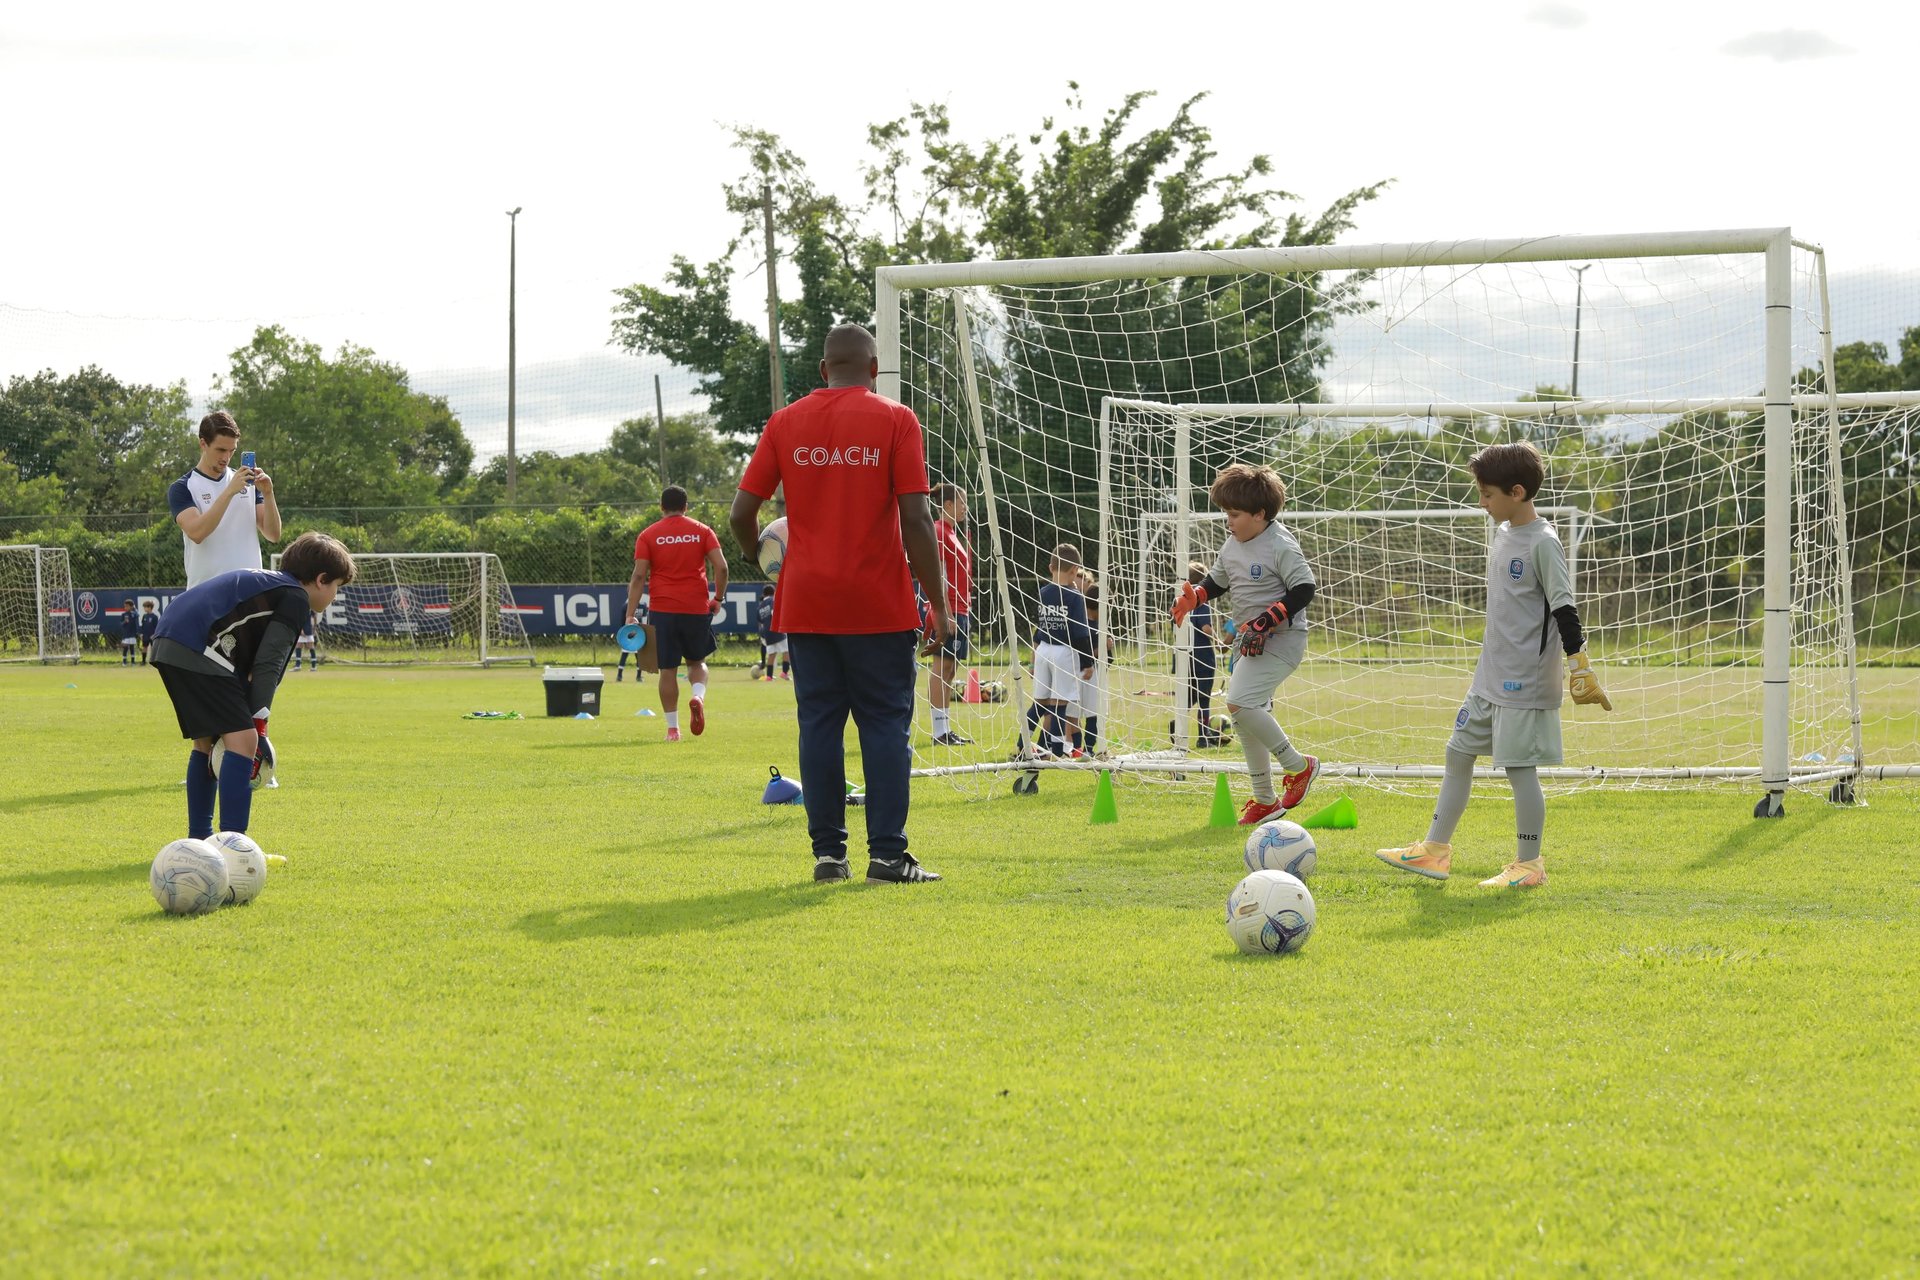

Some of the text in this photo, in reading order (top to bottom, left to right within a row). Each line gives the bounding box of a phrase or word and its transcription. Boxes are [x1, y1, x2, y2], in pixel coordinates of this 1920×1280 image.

[793, 446, 880, 467] COACH
[656, 534, 700, 545] COACH
[554, 593, 611, 626] ICI
[1038, 605, 1069, 618] PARIS
